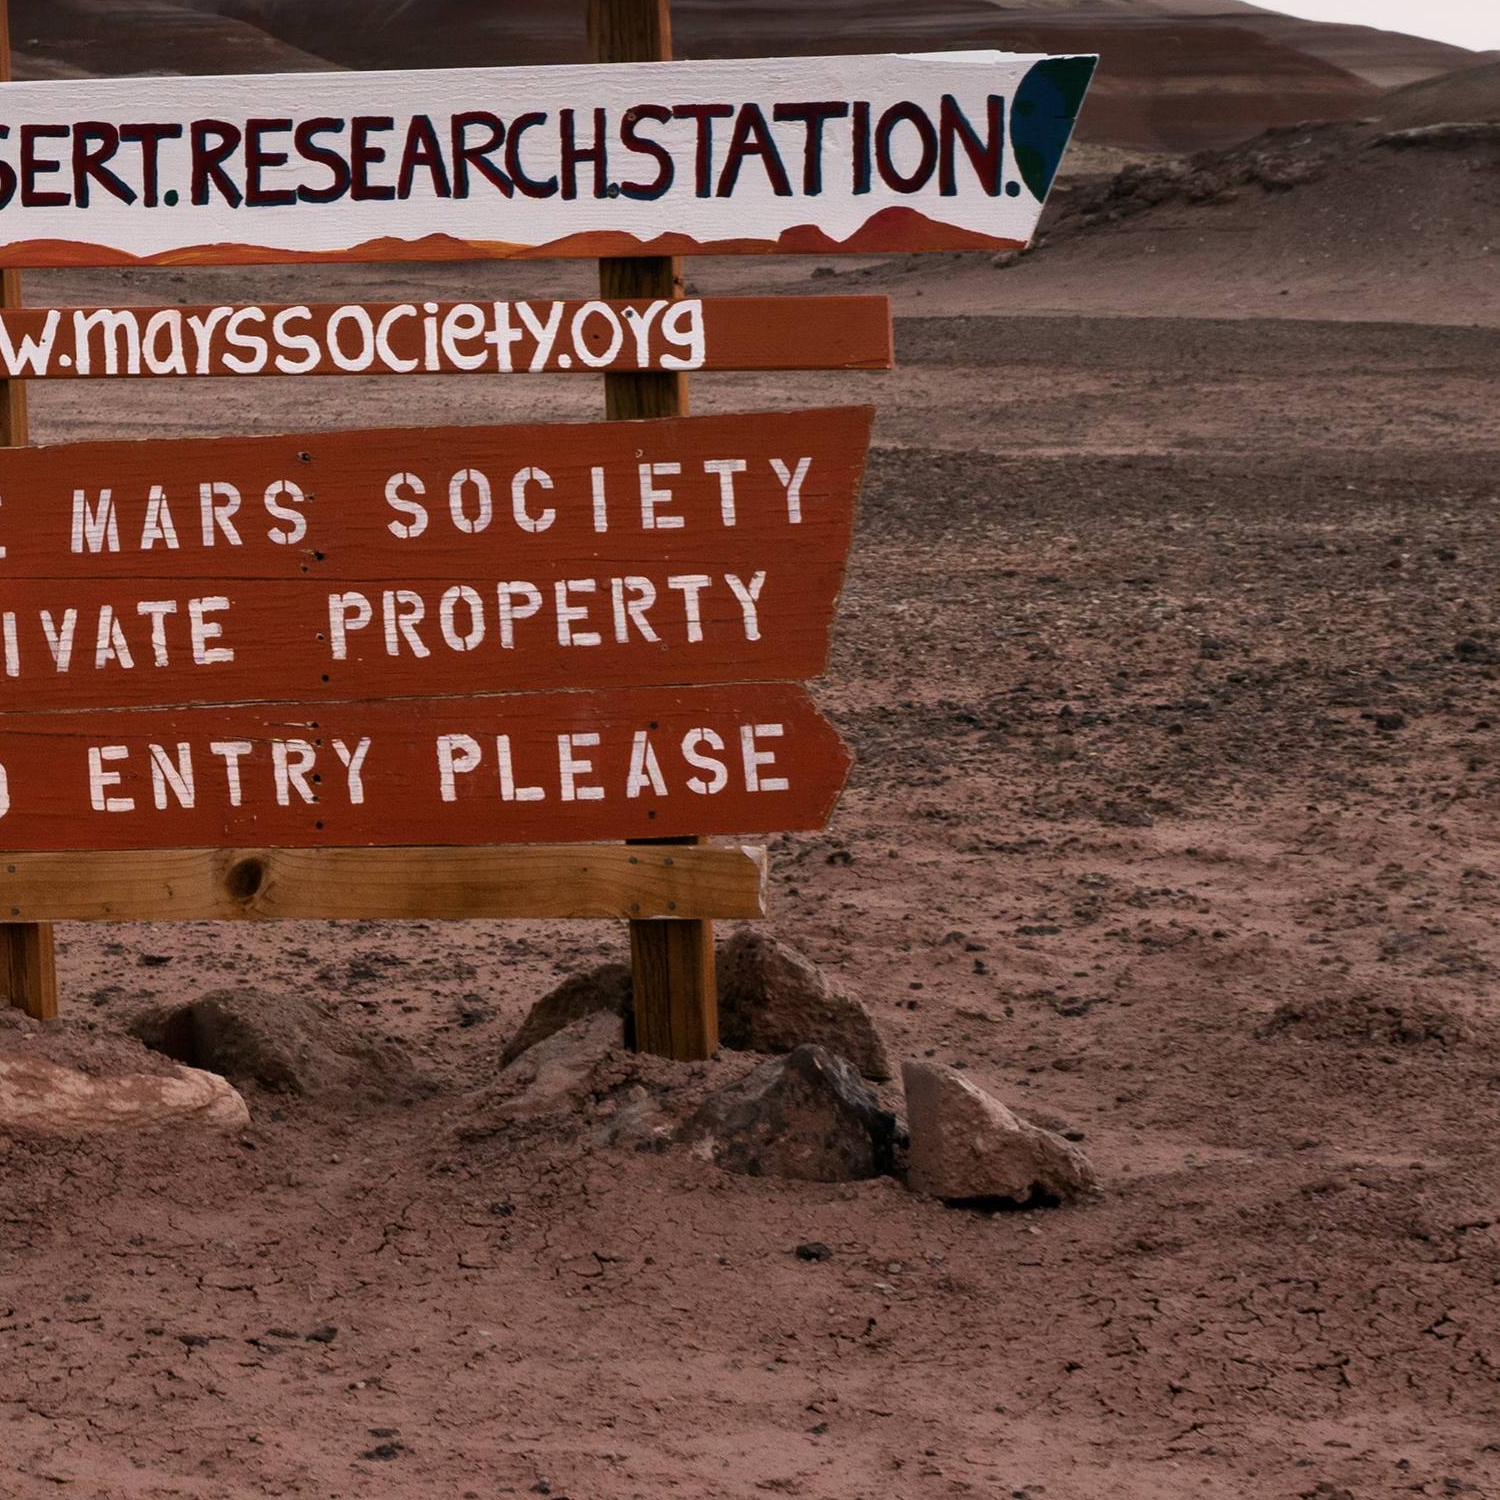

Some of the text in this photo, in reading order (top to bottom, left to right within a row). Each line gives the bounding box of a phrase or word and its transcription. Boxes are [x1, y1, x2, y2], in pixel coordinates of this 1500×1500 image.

[70, 480, 308, 553] MARS
[384, 457, 812, 539] SOCIETY
[328, 570, 767, 660] PROPERTY
[88, 737, 372, 812] ENTRY
[436, 723, 790, 802] PLEASE
